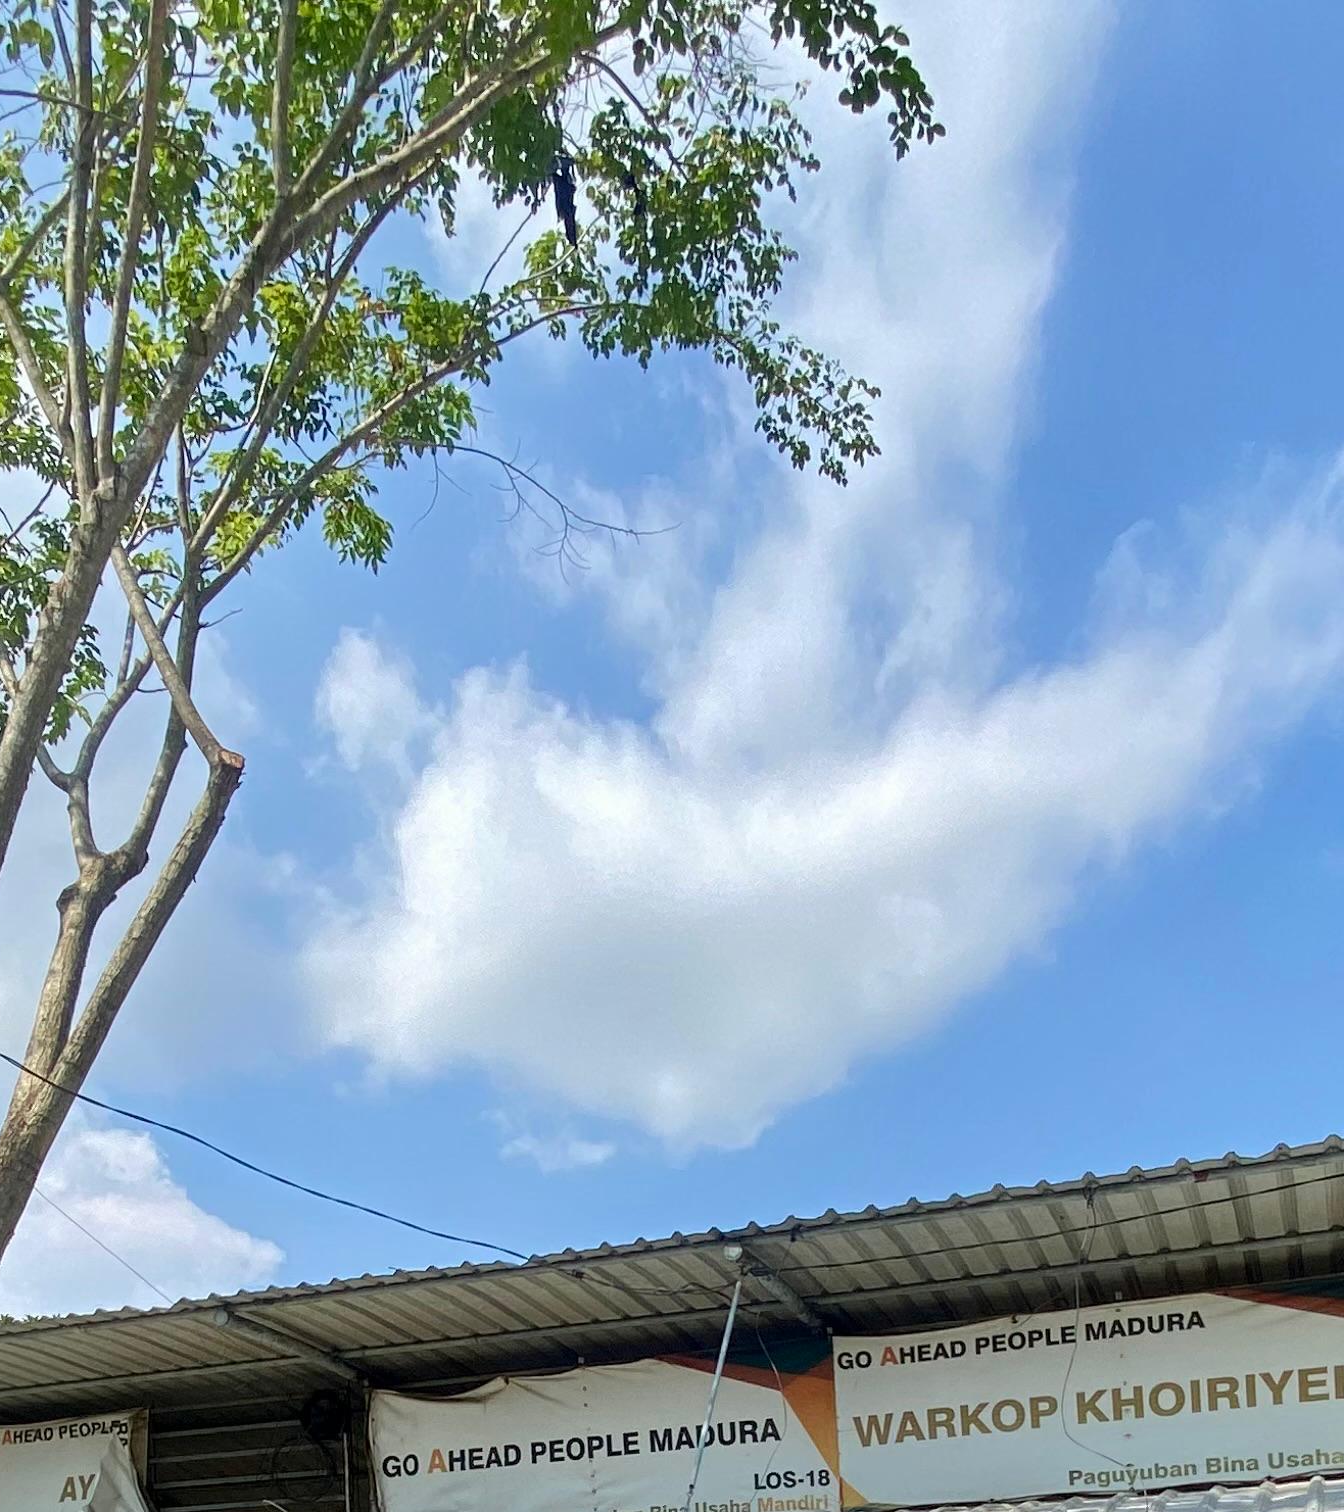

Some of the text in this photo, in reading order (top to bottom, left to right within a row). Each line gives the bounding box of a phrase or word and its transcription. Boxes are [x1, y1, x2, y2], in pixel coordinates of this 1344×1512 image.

[837, 1310, 1206, 1370] GO AHEAD PEOPLE MADURA
[2, 1426, 54, 1446] AHEAD
[853, 1396, 1058, 1448] WARKOP
[381, 1418, 781, 1478] GO AHEAD PEOPLE MADURA
[754, 1470, 830, 1490] LOS-18
[1068, 1460, 1198, 1487] Paguyuban
[1206, 1454, 1259, 1475] Bina
[757, 1494, 829, 1512] Mandiri
